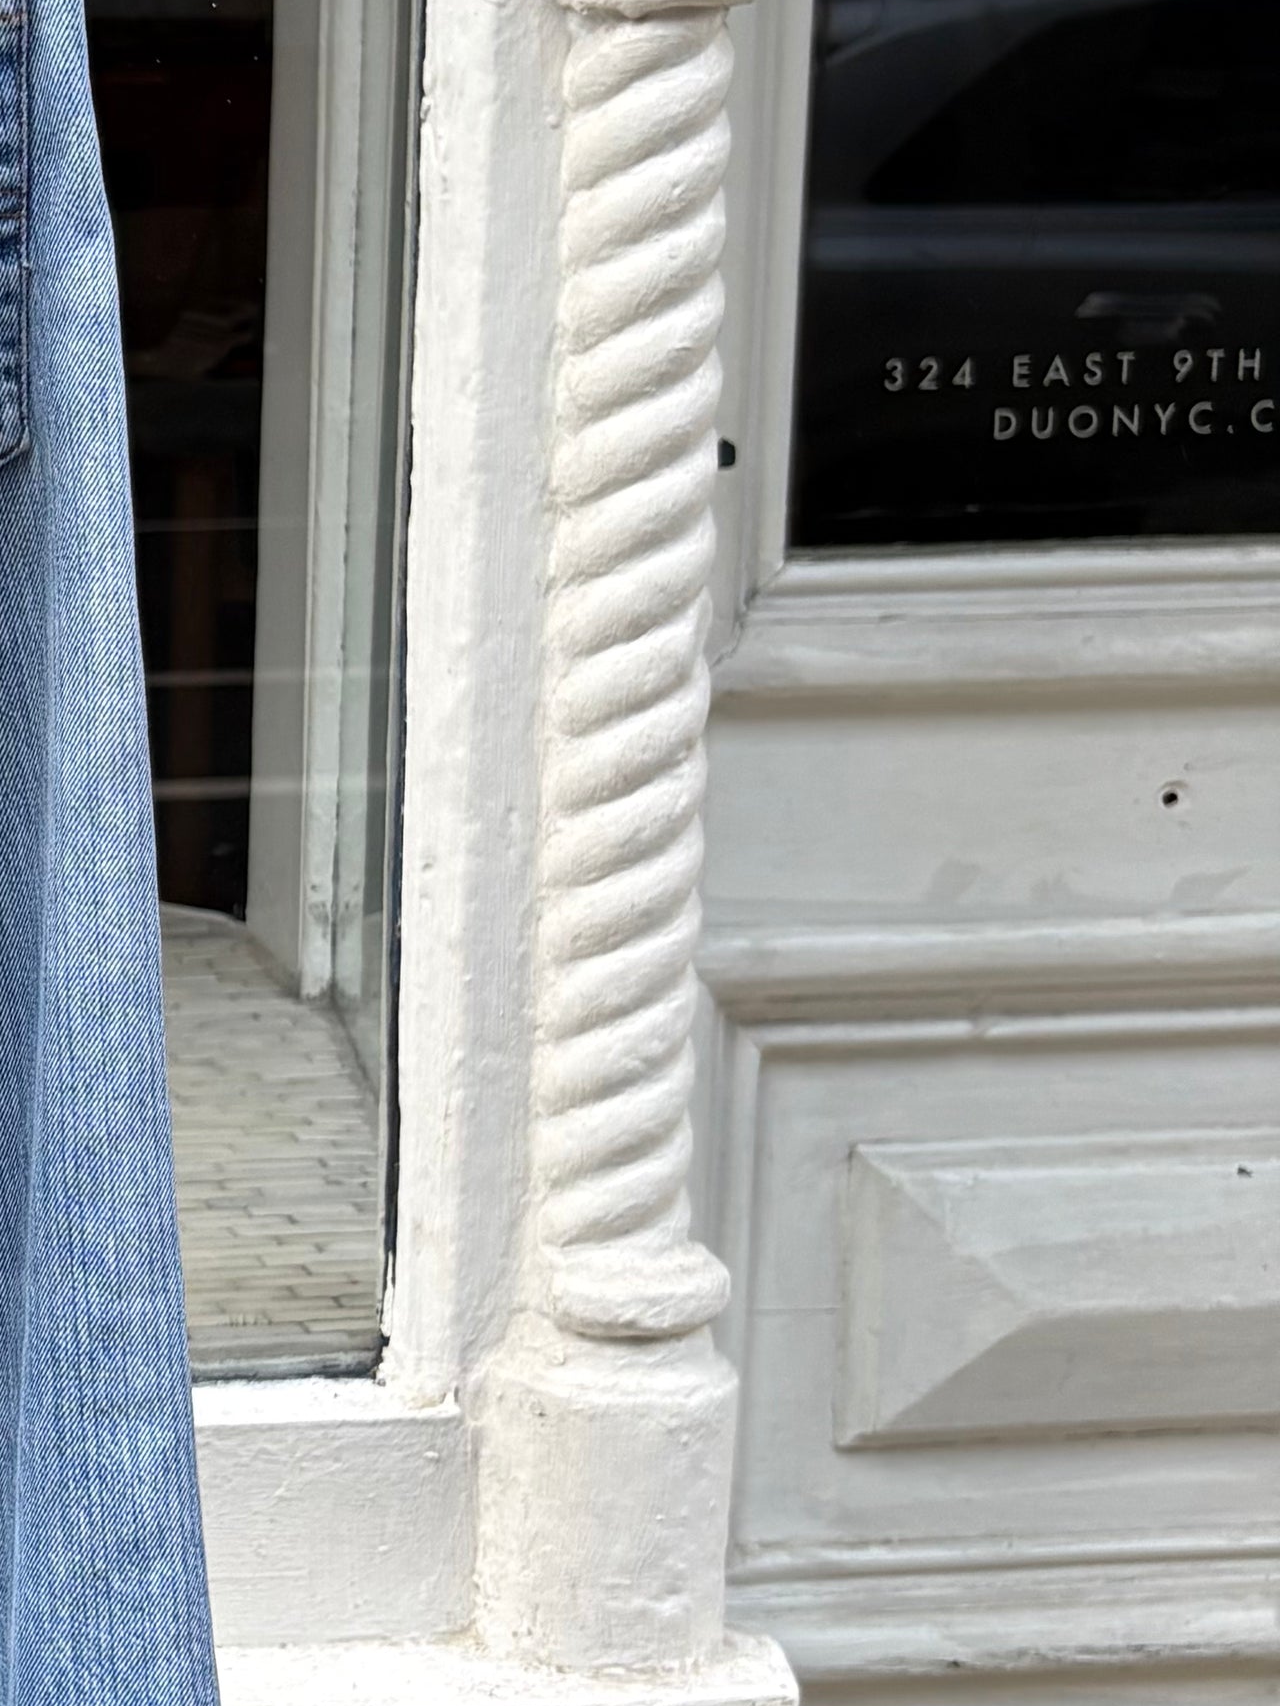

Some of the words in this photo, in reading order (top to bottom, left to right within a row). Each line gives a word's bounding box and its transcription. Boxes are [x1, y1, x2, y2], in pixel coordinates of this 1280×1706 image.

[884, 356, 975, 391] 324
[1012, 351, 1136, 388] EAST
[1173, 348, 1261, 383] 9TH
